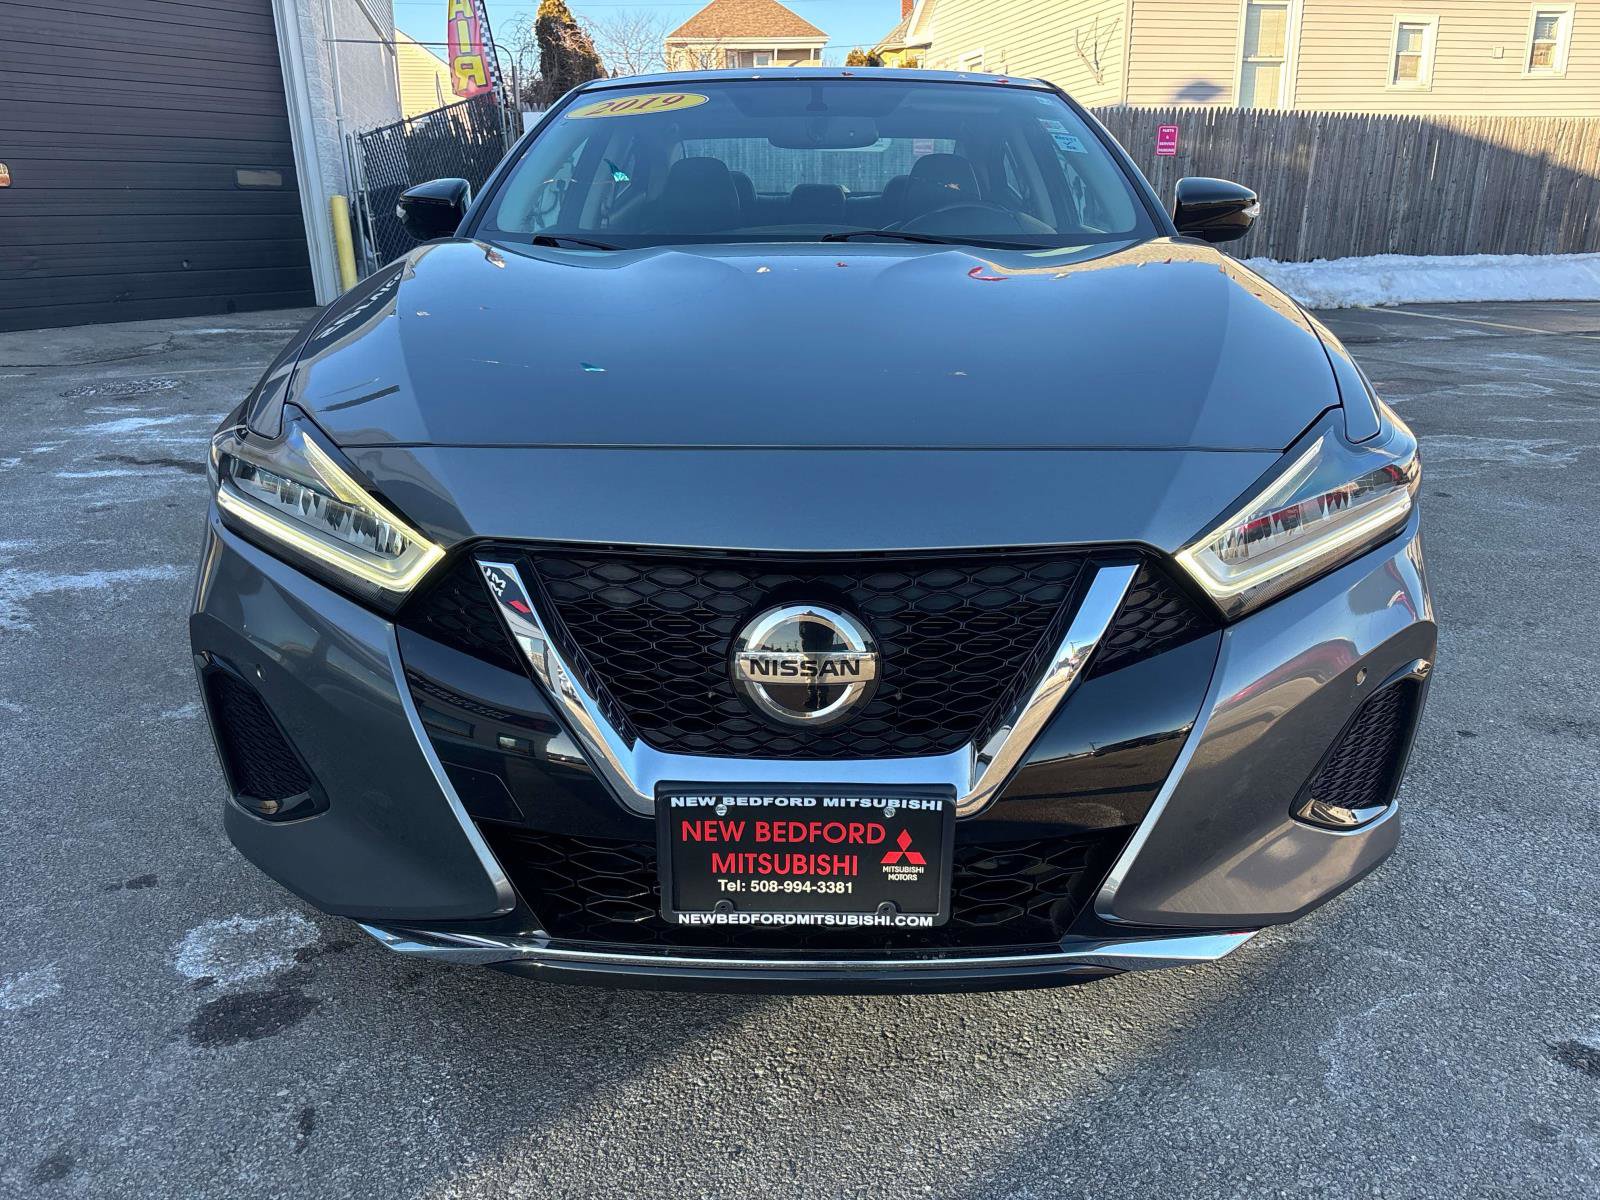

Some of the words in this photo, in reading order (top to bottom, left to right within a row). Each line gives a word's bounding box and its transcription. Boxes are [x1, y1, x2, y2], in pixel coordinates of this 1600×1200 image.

[584, 95, 685, 116] 2019
[749, 659, 860, 677] NISSAN
[670, 797, 717, 807] NEW
[722, 797, 817, 807] BEDFORD
[823, 798, 943, 811] MITSUBISHI
[681, 820, 746, 842] NEW
[755, 821, 887, 844] BEDFORD
[711, 852, 859, 876] MITSUBISHI
[882, 865, 925, 874] MITSUBISHI
[887, 873, 918, 881] MOTORS
[717, 879, 746, 892] Tel:
[750, 880, 853, 894] 508-994-3381
[678, 913, 933, 927] NEWBEDFORDMITSUBISHI.COM
